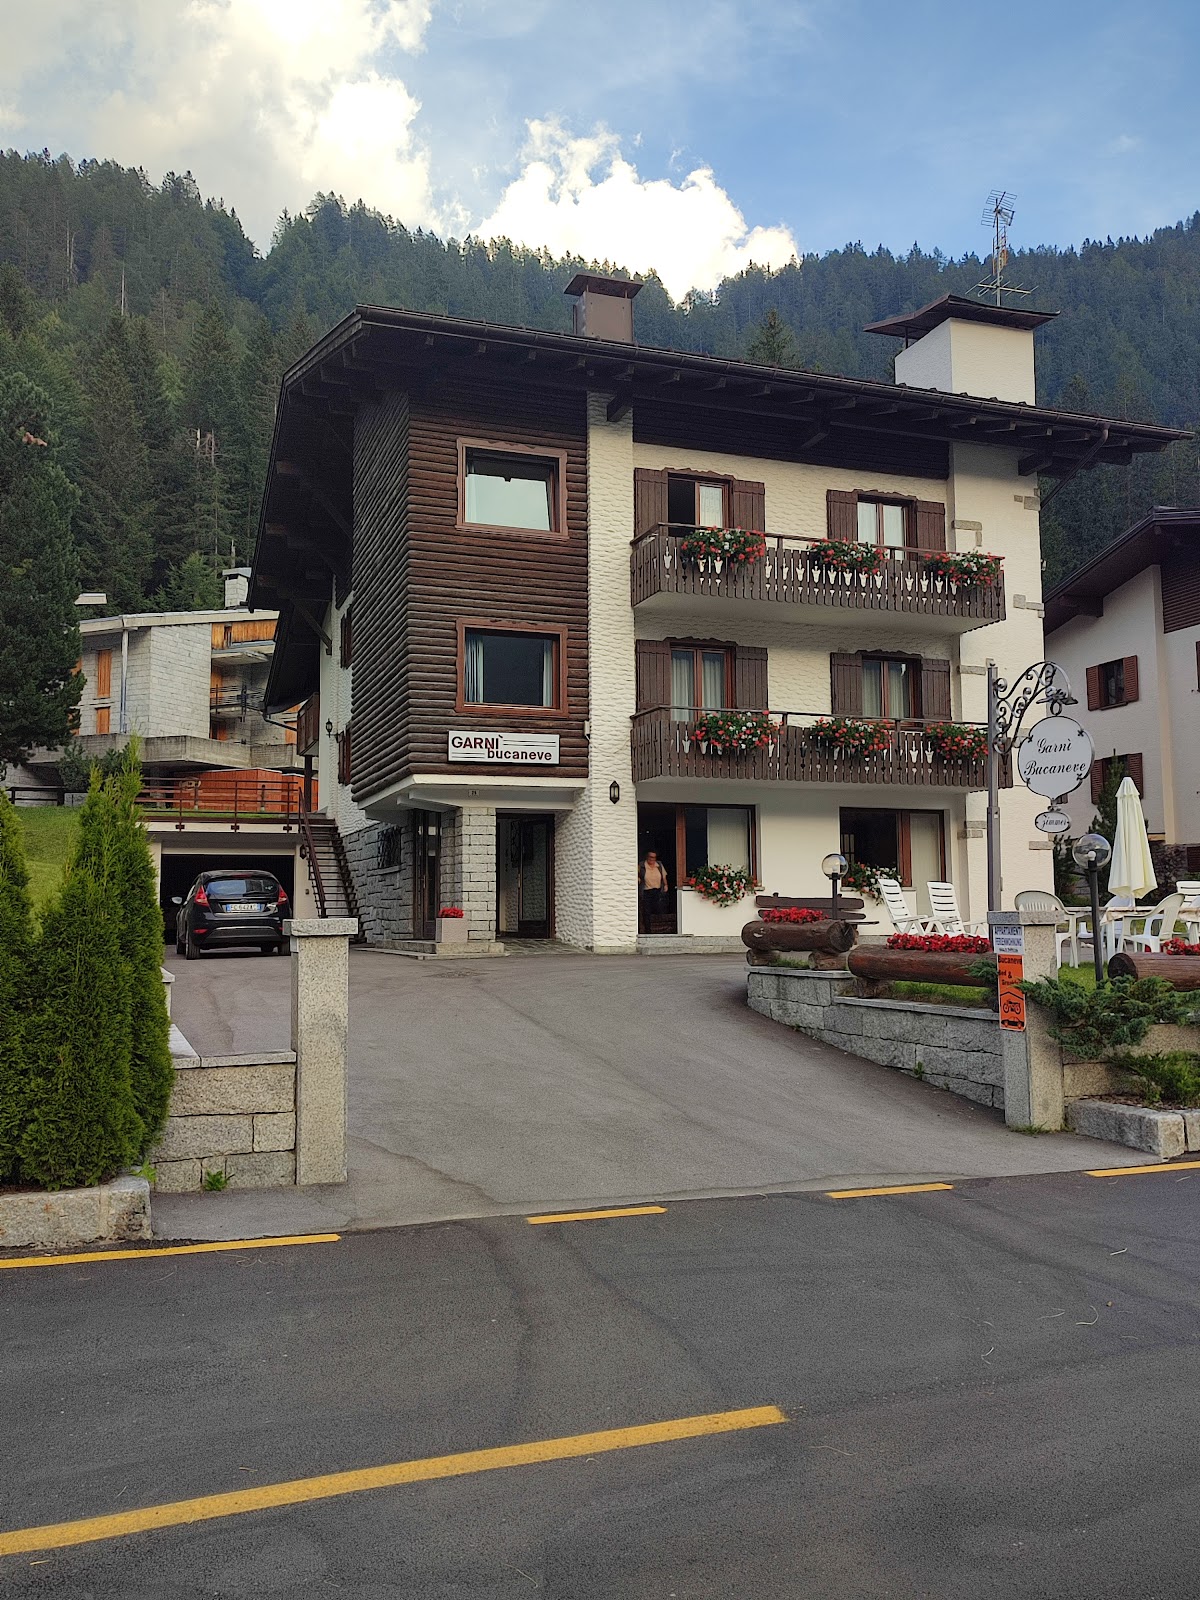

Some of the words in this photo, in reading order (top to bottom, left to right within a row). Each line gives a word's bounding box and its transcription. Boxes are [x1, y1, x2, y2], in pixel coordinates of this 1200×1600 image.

[451, 734, 503, 750] GARNÌ
[487, 748, 552, 761] bucaneve
[1023, 760, 1087, 776] Bucaneve
[998, 955, 1022, 965] Bucaneve
